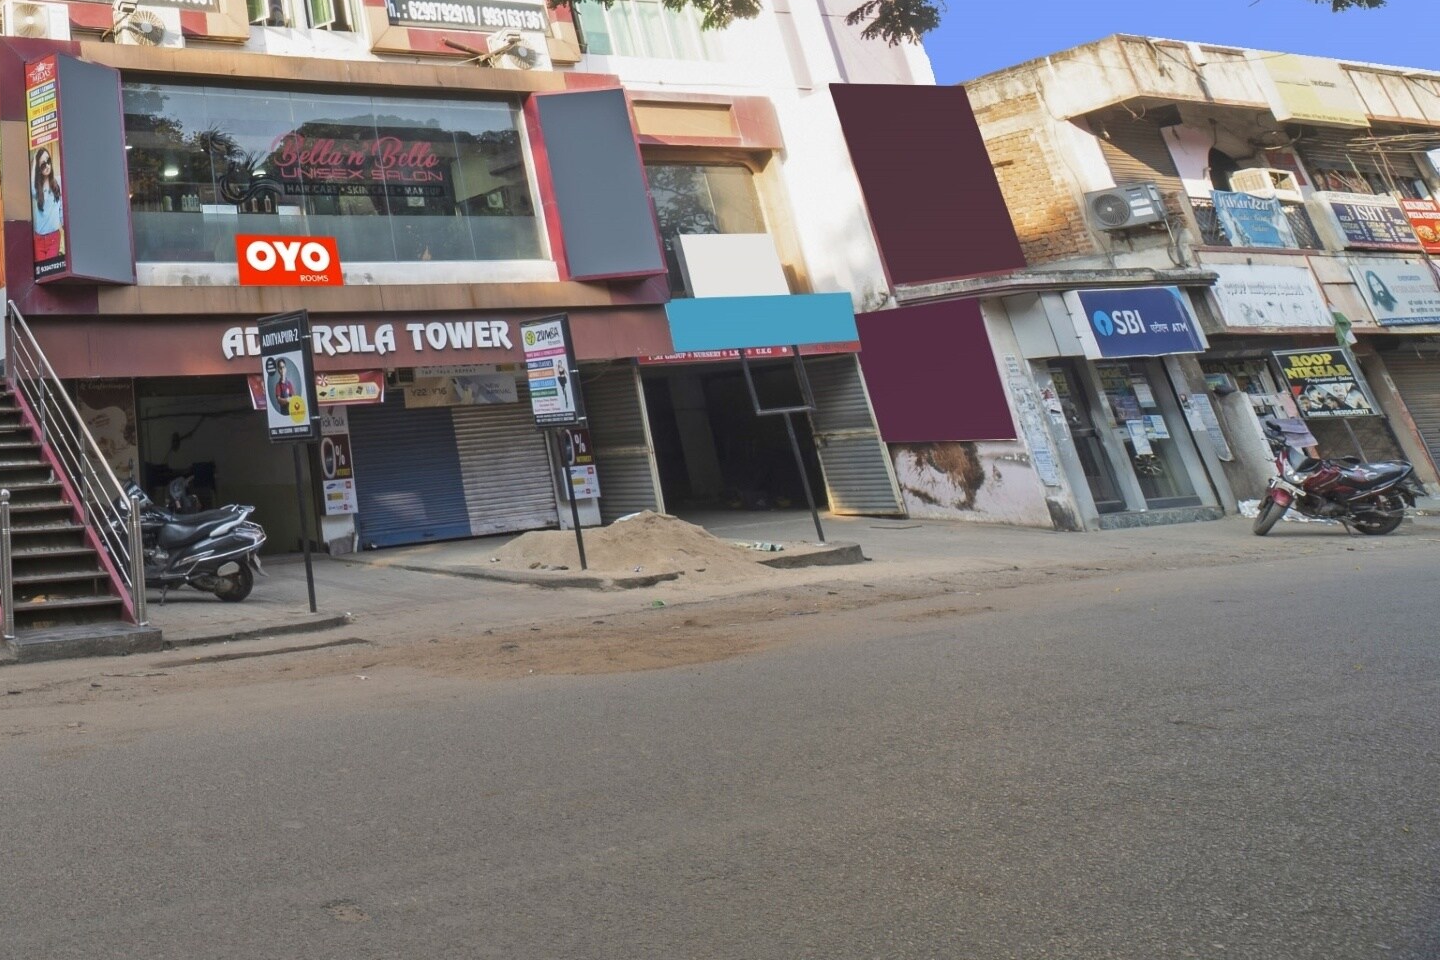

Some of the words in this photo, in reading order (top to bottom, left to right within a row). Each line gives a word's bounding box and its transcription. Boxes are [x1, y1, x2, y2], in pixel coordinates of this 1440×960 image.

[280, 167, 365, 180] UNISEX
[371, 169, 443, 182] SALON
[287, 184, 310, 193] HAIR
[312, 185, 337, 193] CARE
[346, 185, 368, 194] SKIN
[245, 240, 330, 271] OYO
[300, 274, 329, 282] ROOMS
[1112, 310, 1146, 335] SBI
[1172, 322, 1188, 332] ATM
[262, 328, 299, 347] ADITYAPUR-2
[405, 320, 513, 350] TOWER
[1289, 353, 1333, 367] ROOP
[1284, 364, 1351, 379] NIKHAR
